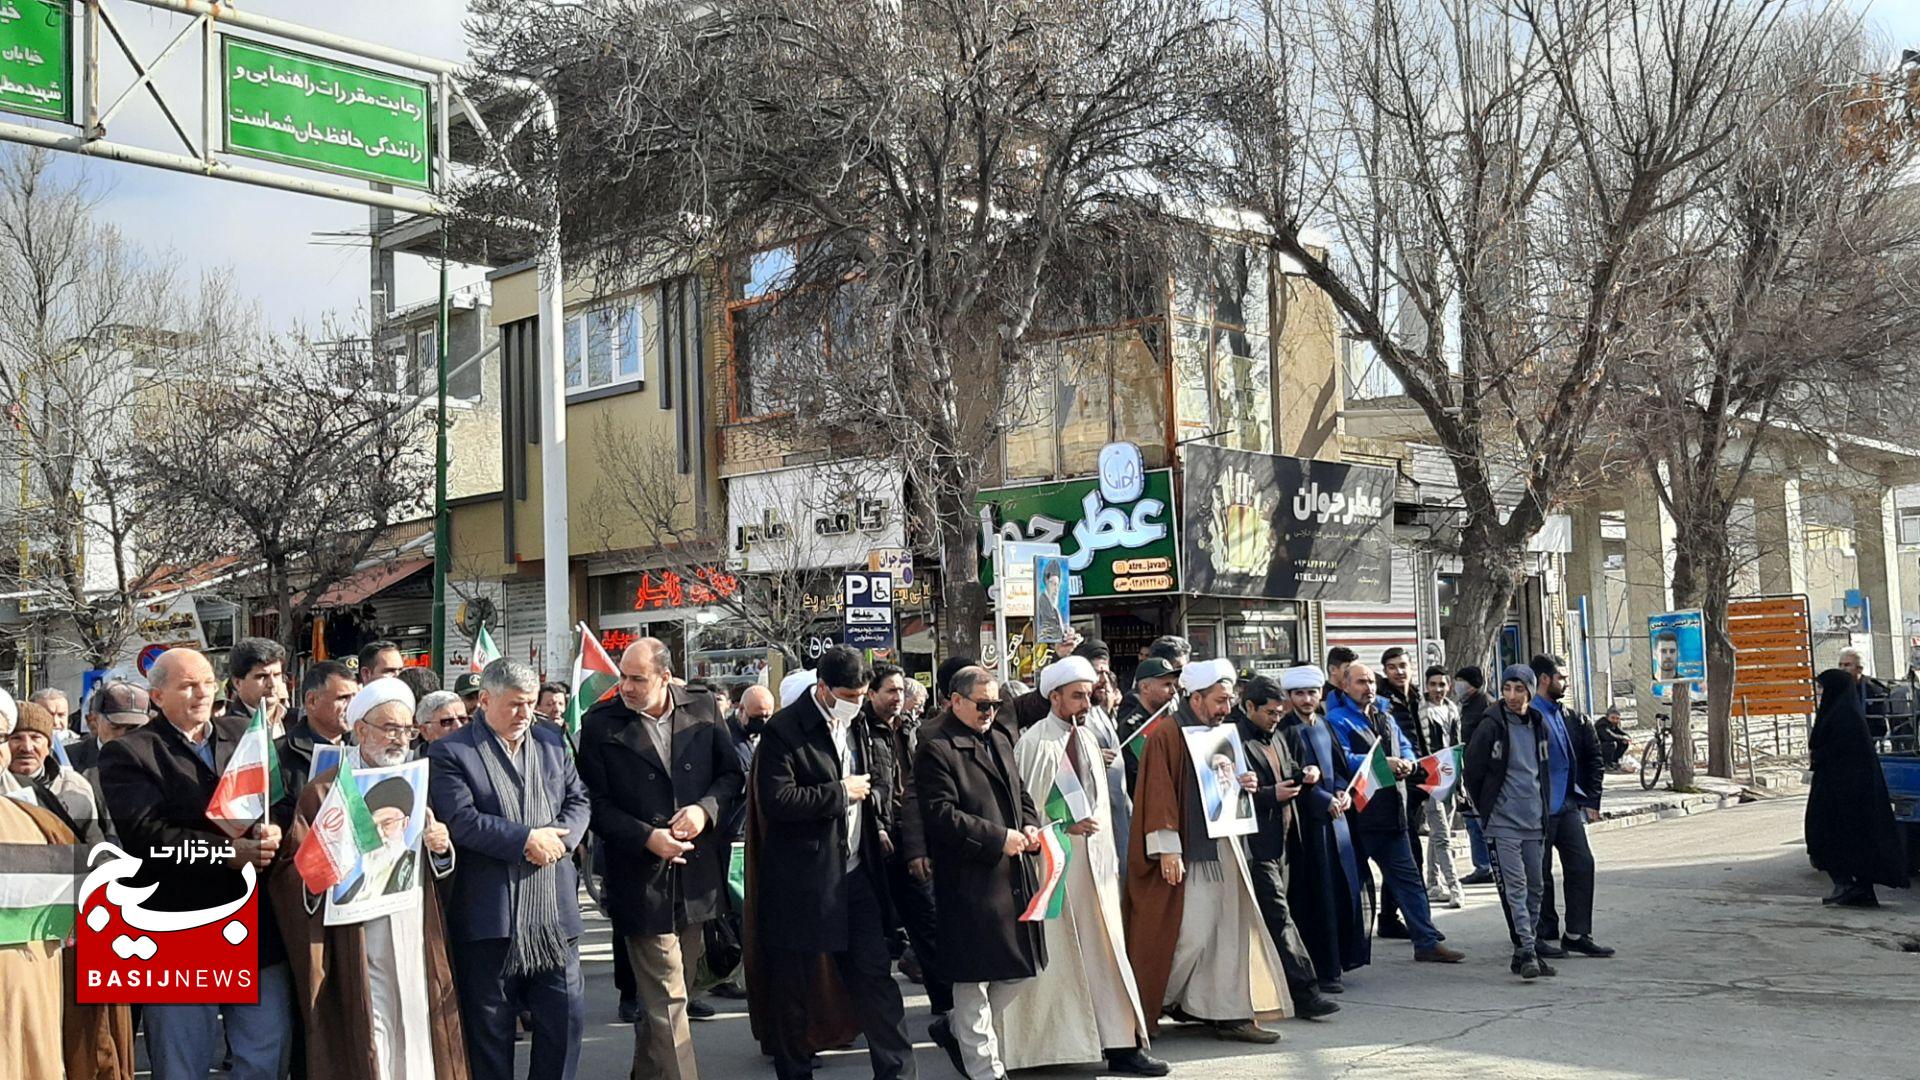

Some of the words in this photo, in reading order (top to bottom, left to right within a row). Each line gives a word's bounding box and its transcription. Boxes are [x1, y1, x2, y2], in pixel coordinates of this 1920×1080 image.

[2, 45, 45, 67] خیابان
[233, 65, 244, 79] و
[246, 65, 315, 97] راهنمایی
[25, 81, 62, 103] شهید
[315, 80, 379, 106] مقررات
[230, 108, 296, 135] شماست
[375, 96, 422, 121] رعایت
[294, 121, 325, 145] جان
[325, 126, 364, 150] حافظ
[365, 136, 422, 164] رانندگی
[1293, 482, 1346, 524] جوان
[1343, 486, 1382, 526] عطر
[1068, 488, 1167, 571] عطر
[845, 574, 869, 605] P
